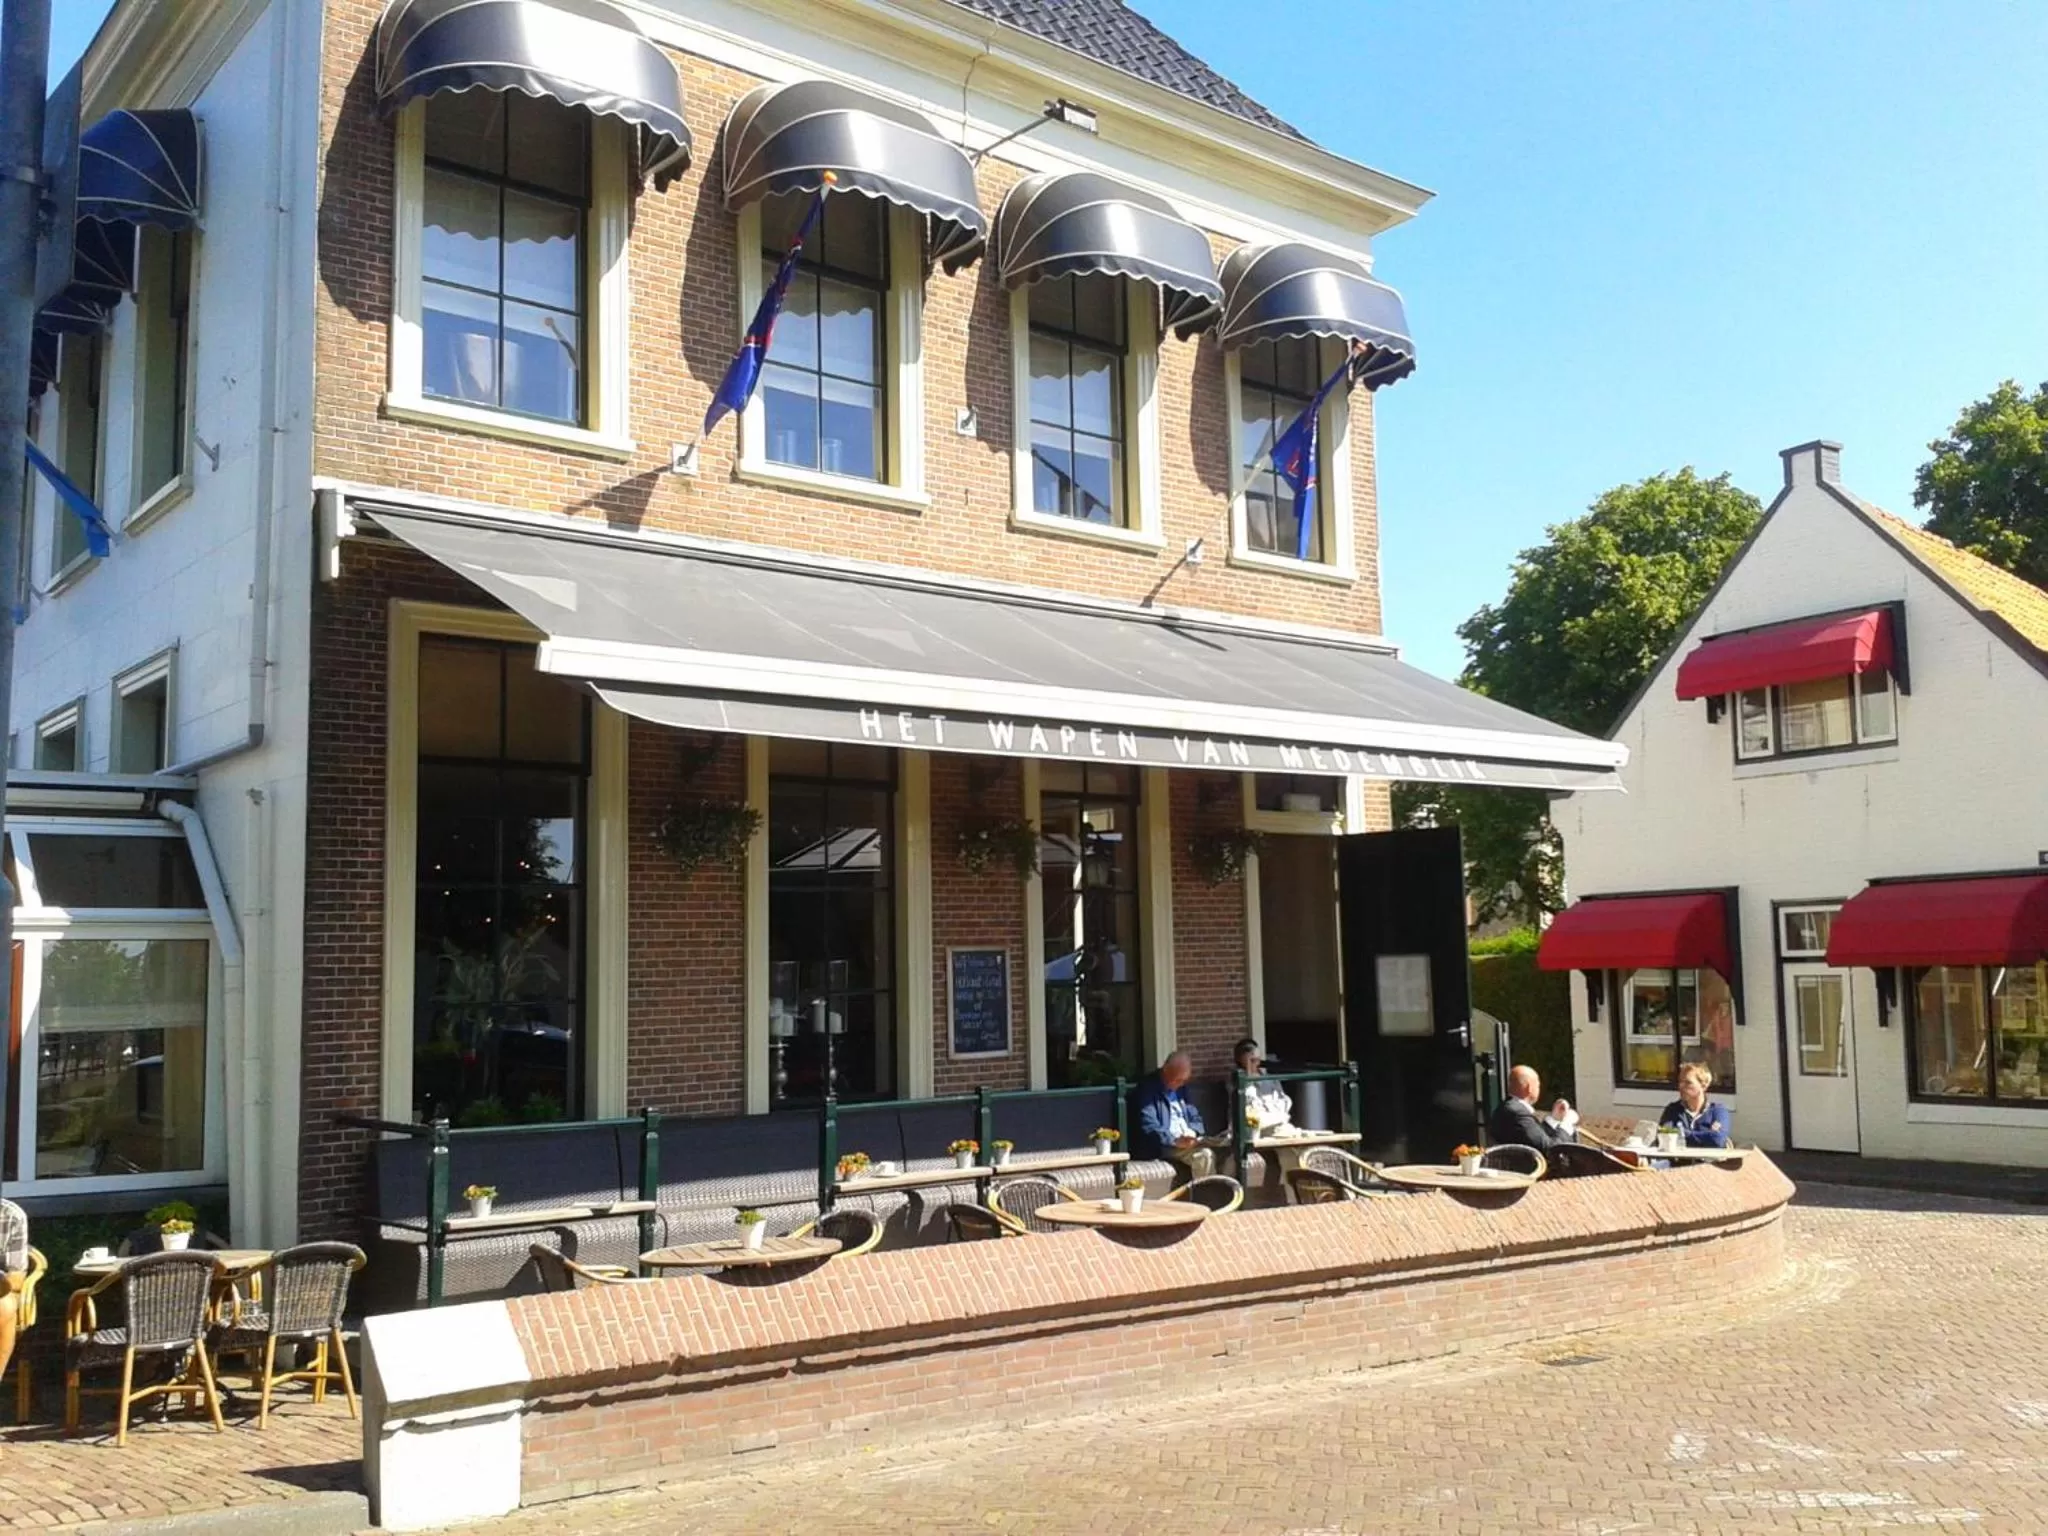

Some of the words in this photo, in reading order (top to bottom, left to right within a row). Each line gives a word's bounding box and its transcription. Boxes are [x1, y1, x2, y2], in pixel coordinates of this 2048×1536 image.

[859, 707, 947, 745] HET
[987, 718, 1138, 760] WAPEN
[1172, 734, 1250, 766] VAN
[1278, 743, 1487, 780] MEDEMBLIK
